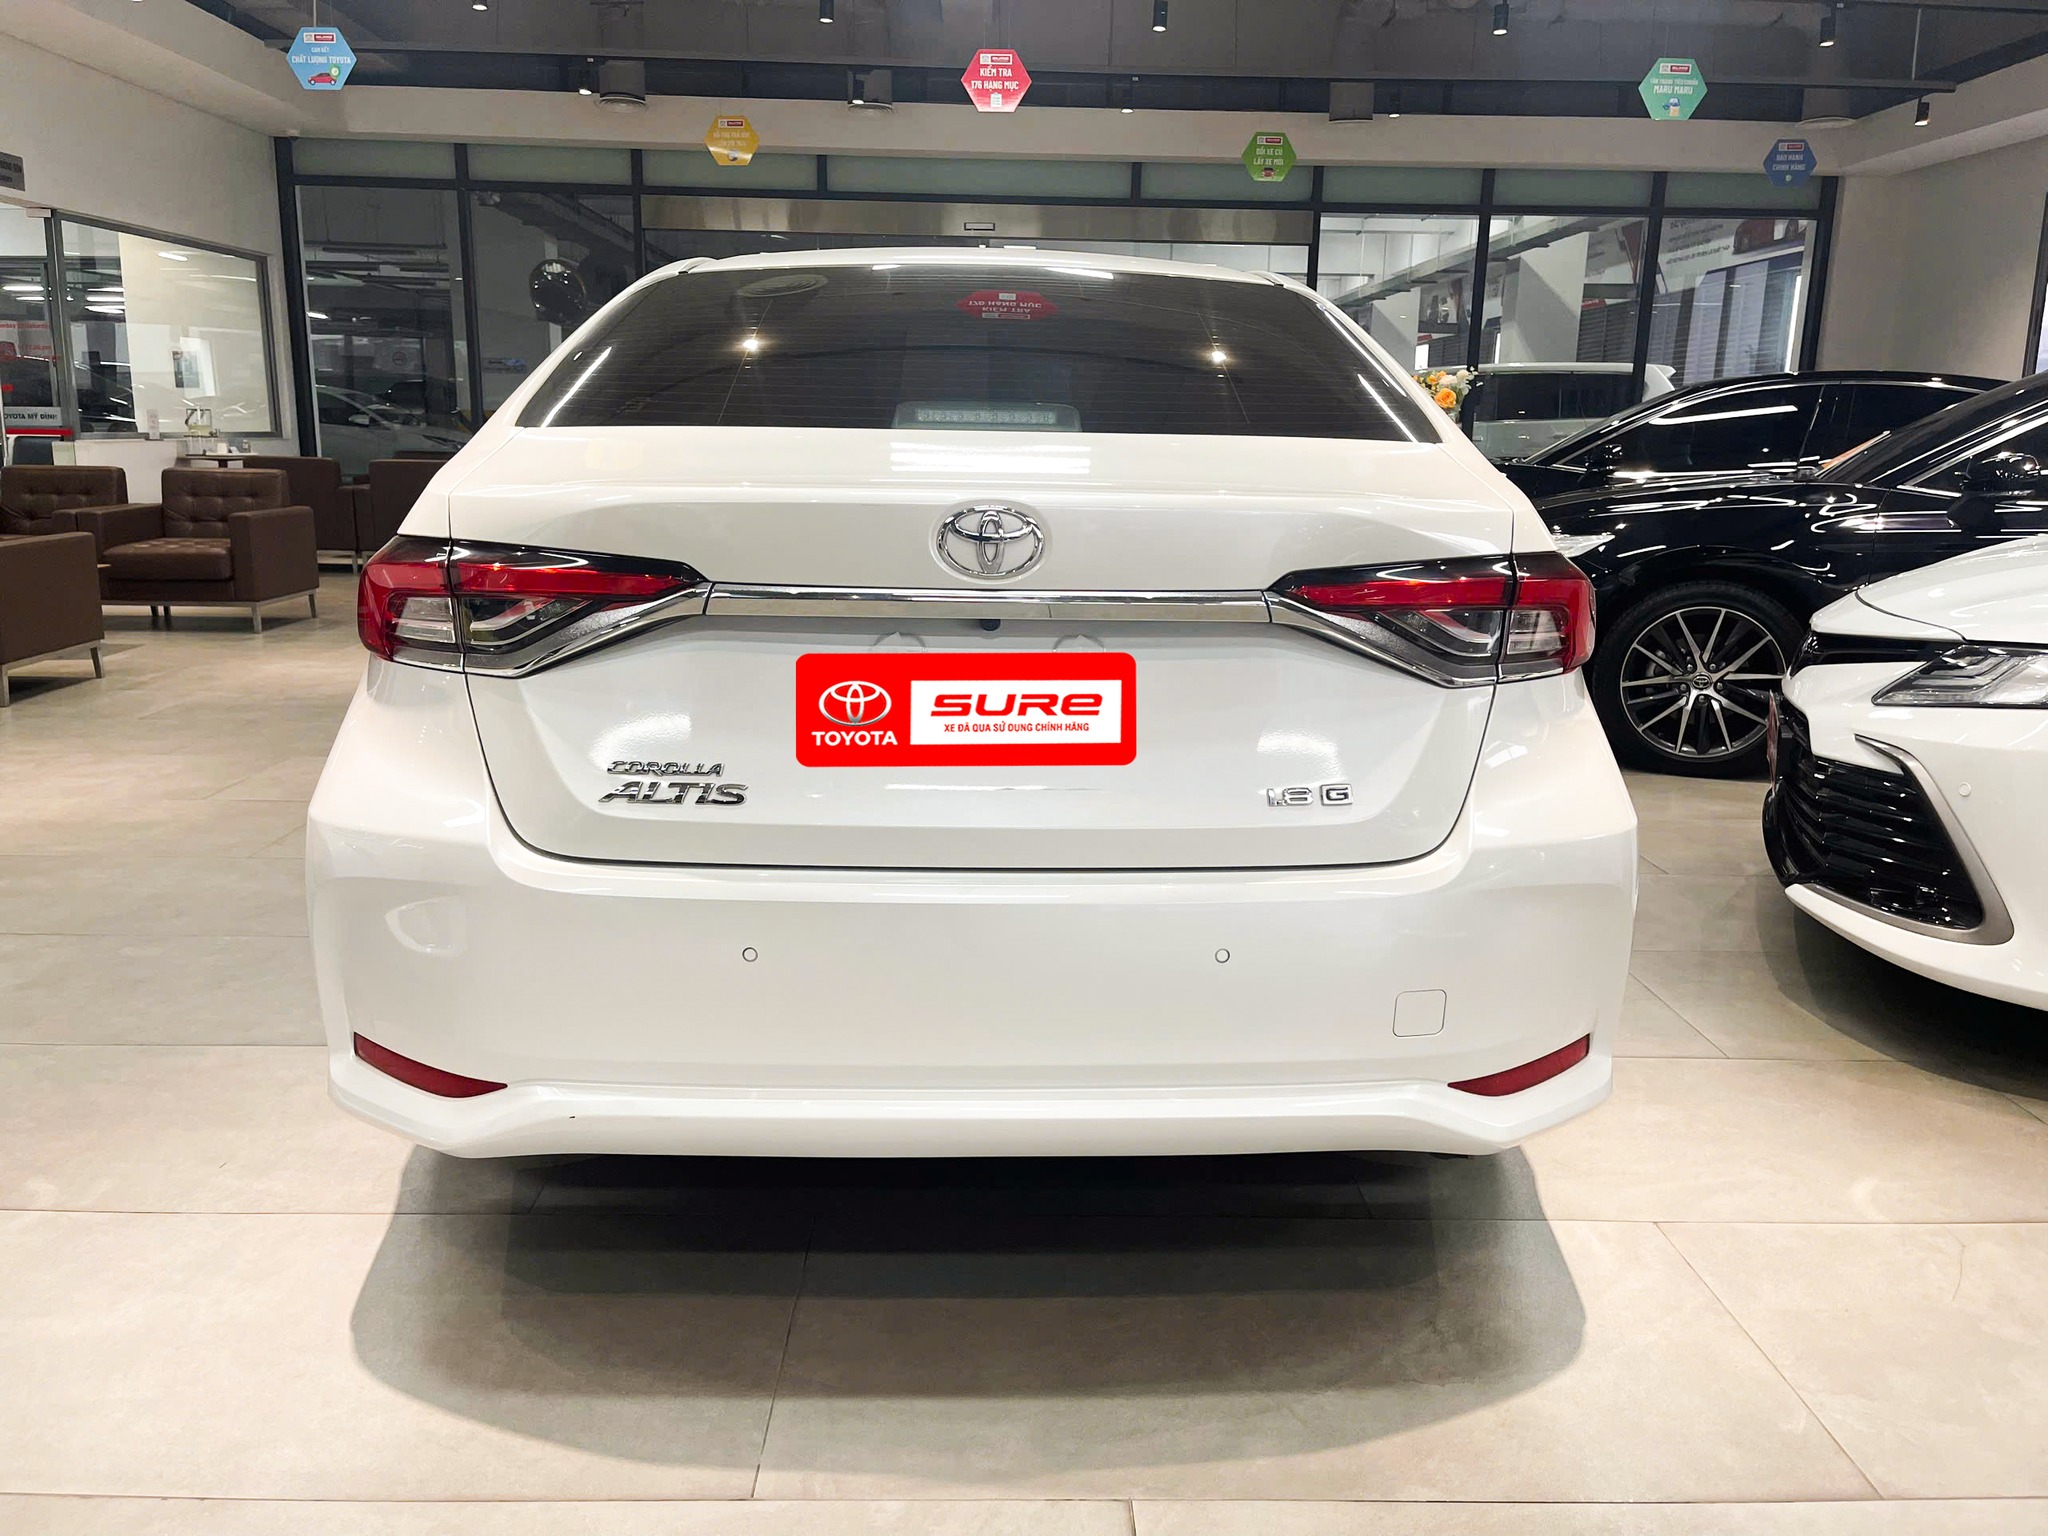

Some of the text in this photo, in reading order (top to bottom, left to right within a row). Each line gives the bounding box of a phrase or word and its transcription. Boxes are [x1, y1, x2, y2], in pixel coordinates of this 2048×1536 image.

[292, 54, 306, 64] CHẤT
[328, 56, 352, 64] TOYOTA
[980, 64, 1012, 77] KIỂM TRA
[970, 80, 1019, 92] 176 HẠNG MỤC
[1654, 85, 1693, 95] MARU MARU
[607, 760, 725, 777] COROLLA
[598, 780, 748, 805] ALTIS
[1266, 784, 1352, 806] 1.8 G
